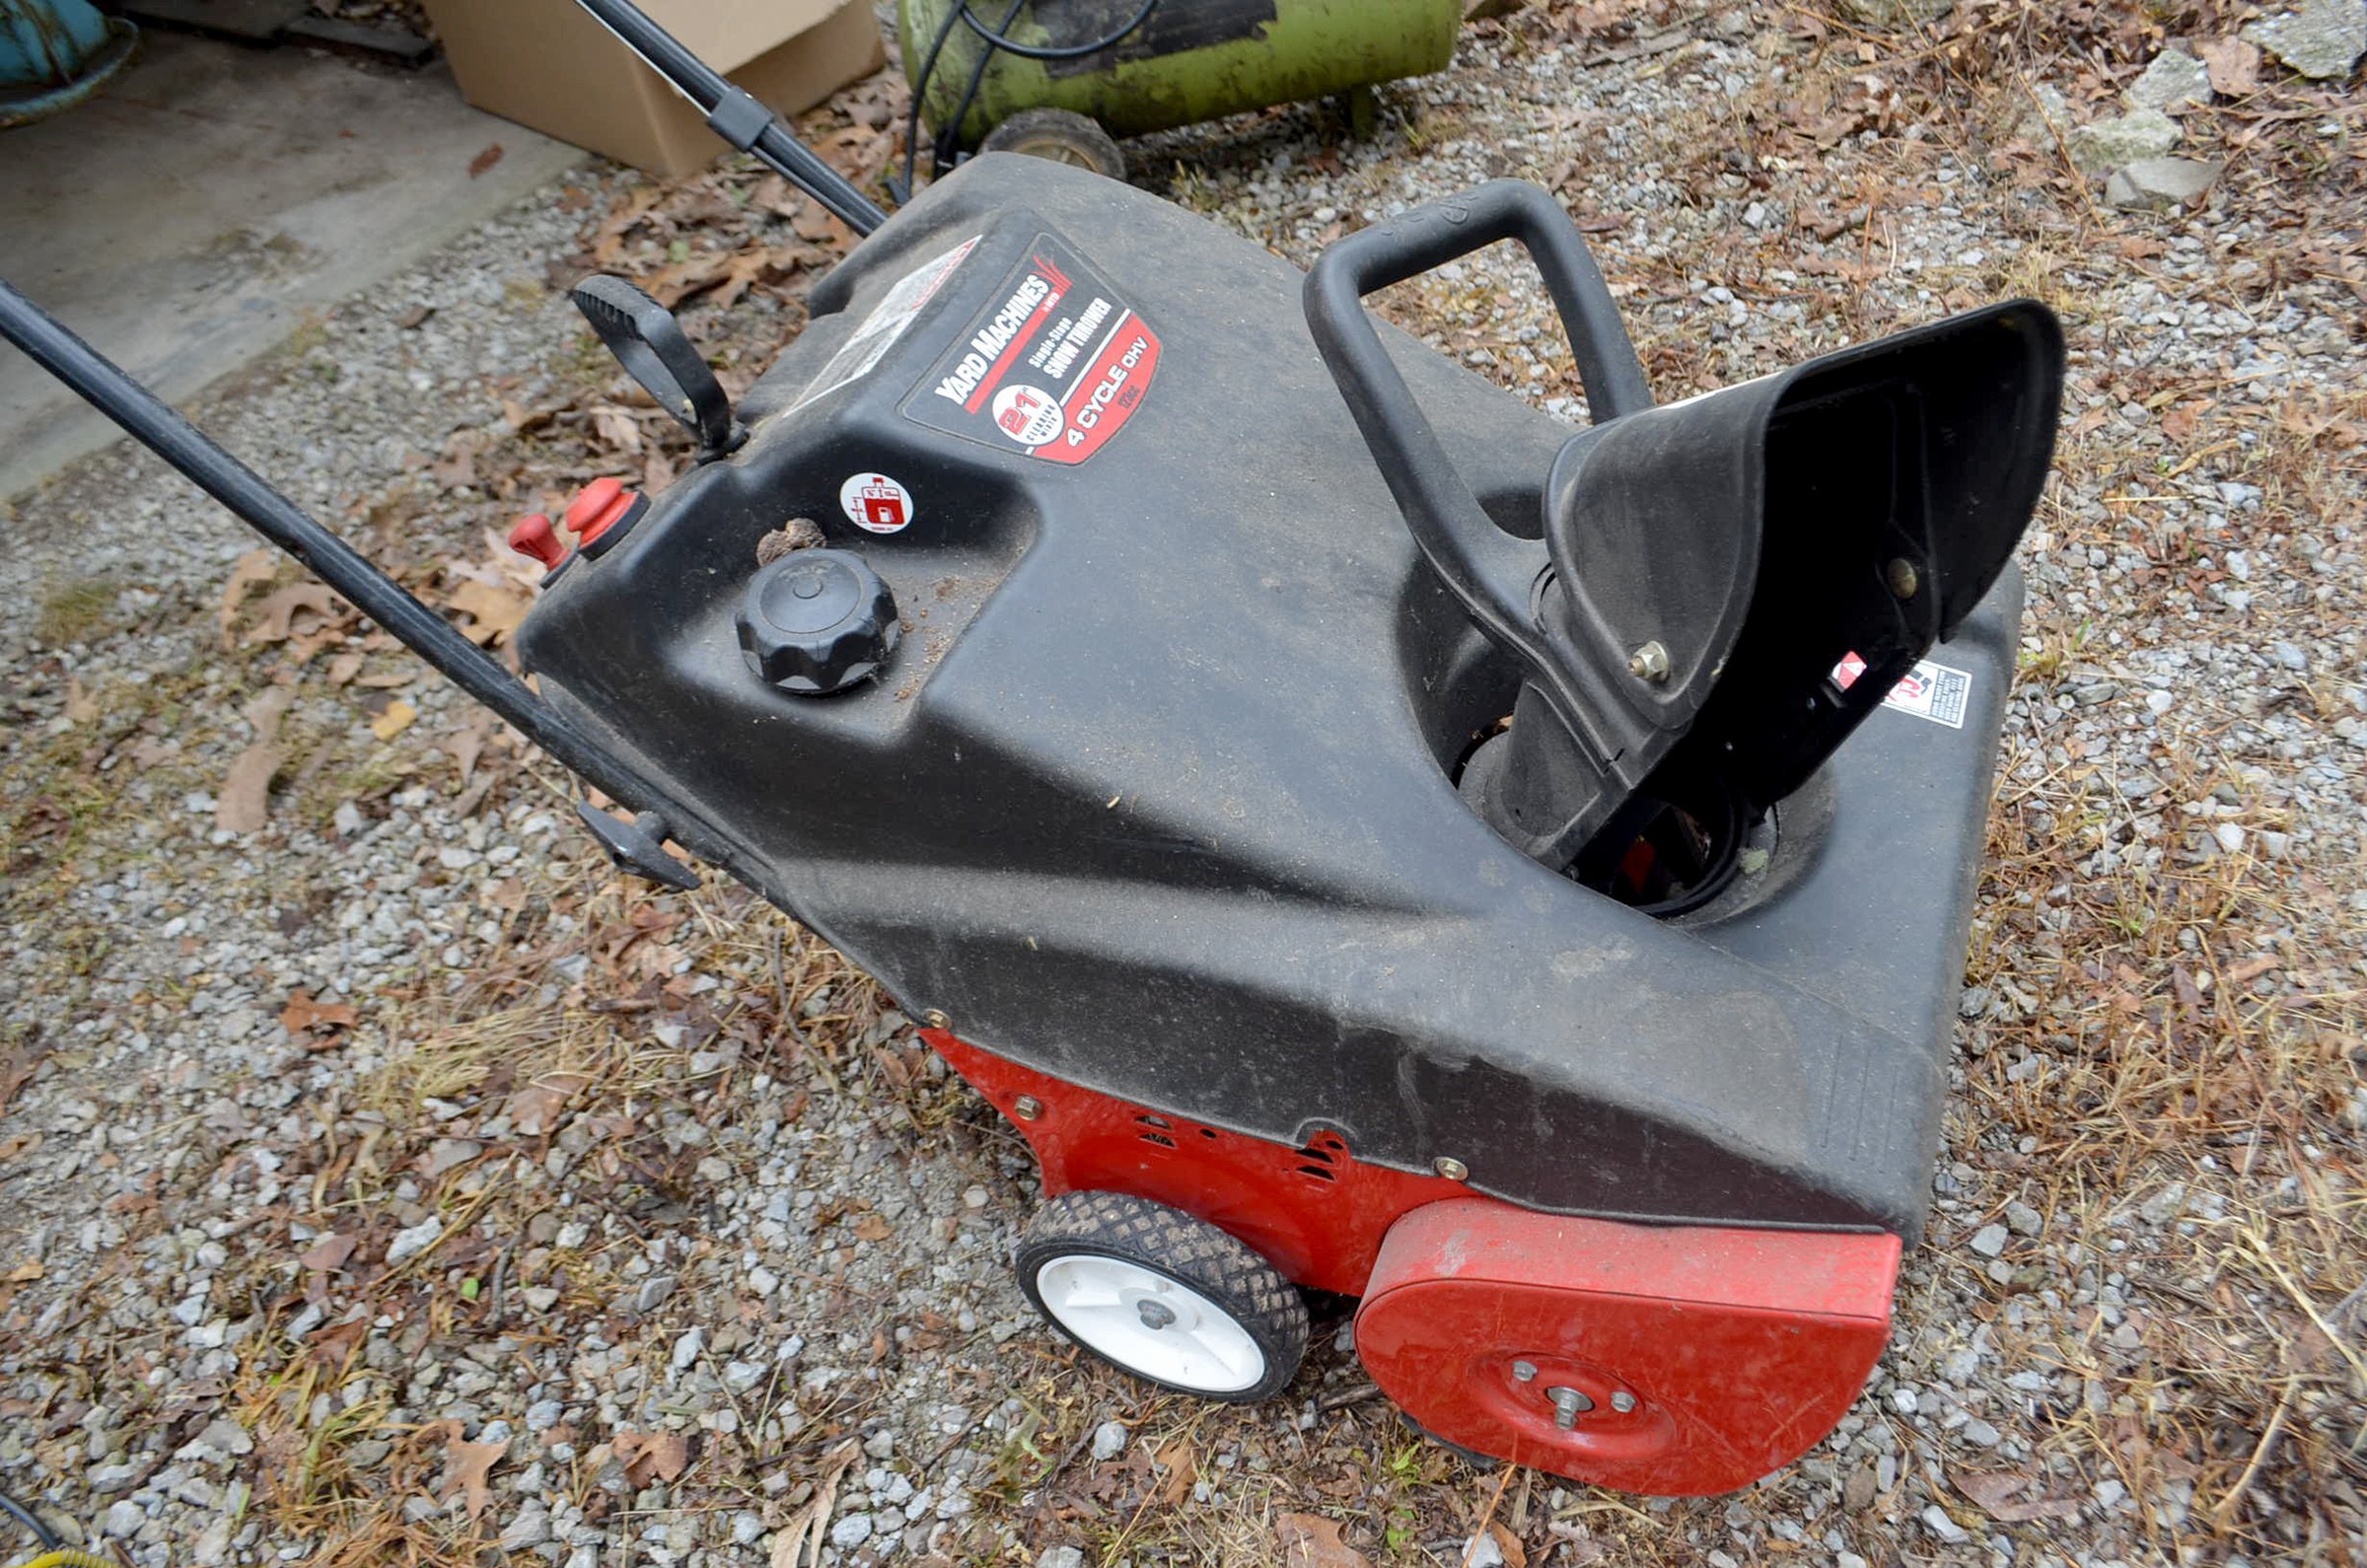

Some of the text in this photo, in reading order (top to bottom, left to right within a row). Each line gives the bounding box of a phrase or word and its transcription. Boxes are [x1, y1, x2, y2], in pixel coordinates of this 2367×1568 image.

[934, 353, 988, 405] YARD
[970, 275, 1049, 361] MACHINES
[1042, 297, 1112, 379] SNOW THROWER
[999, 392, 1041, 436] 21
[1027, 404, 1056, 441] CLEARING
[1067, 335, 1150, 447] 4 CYCLE OHV
